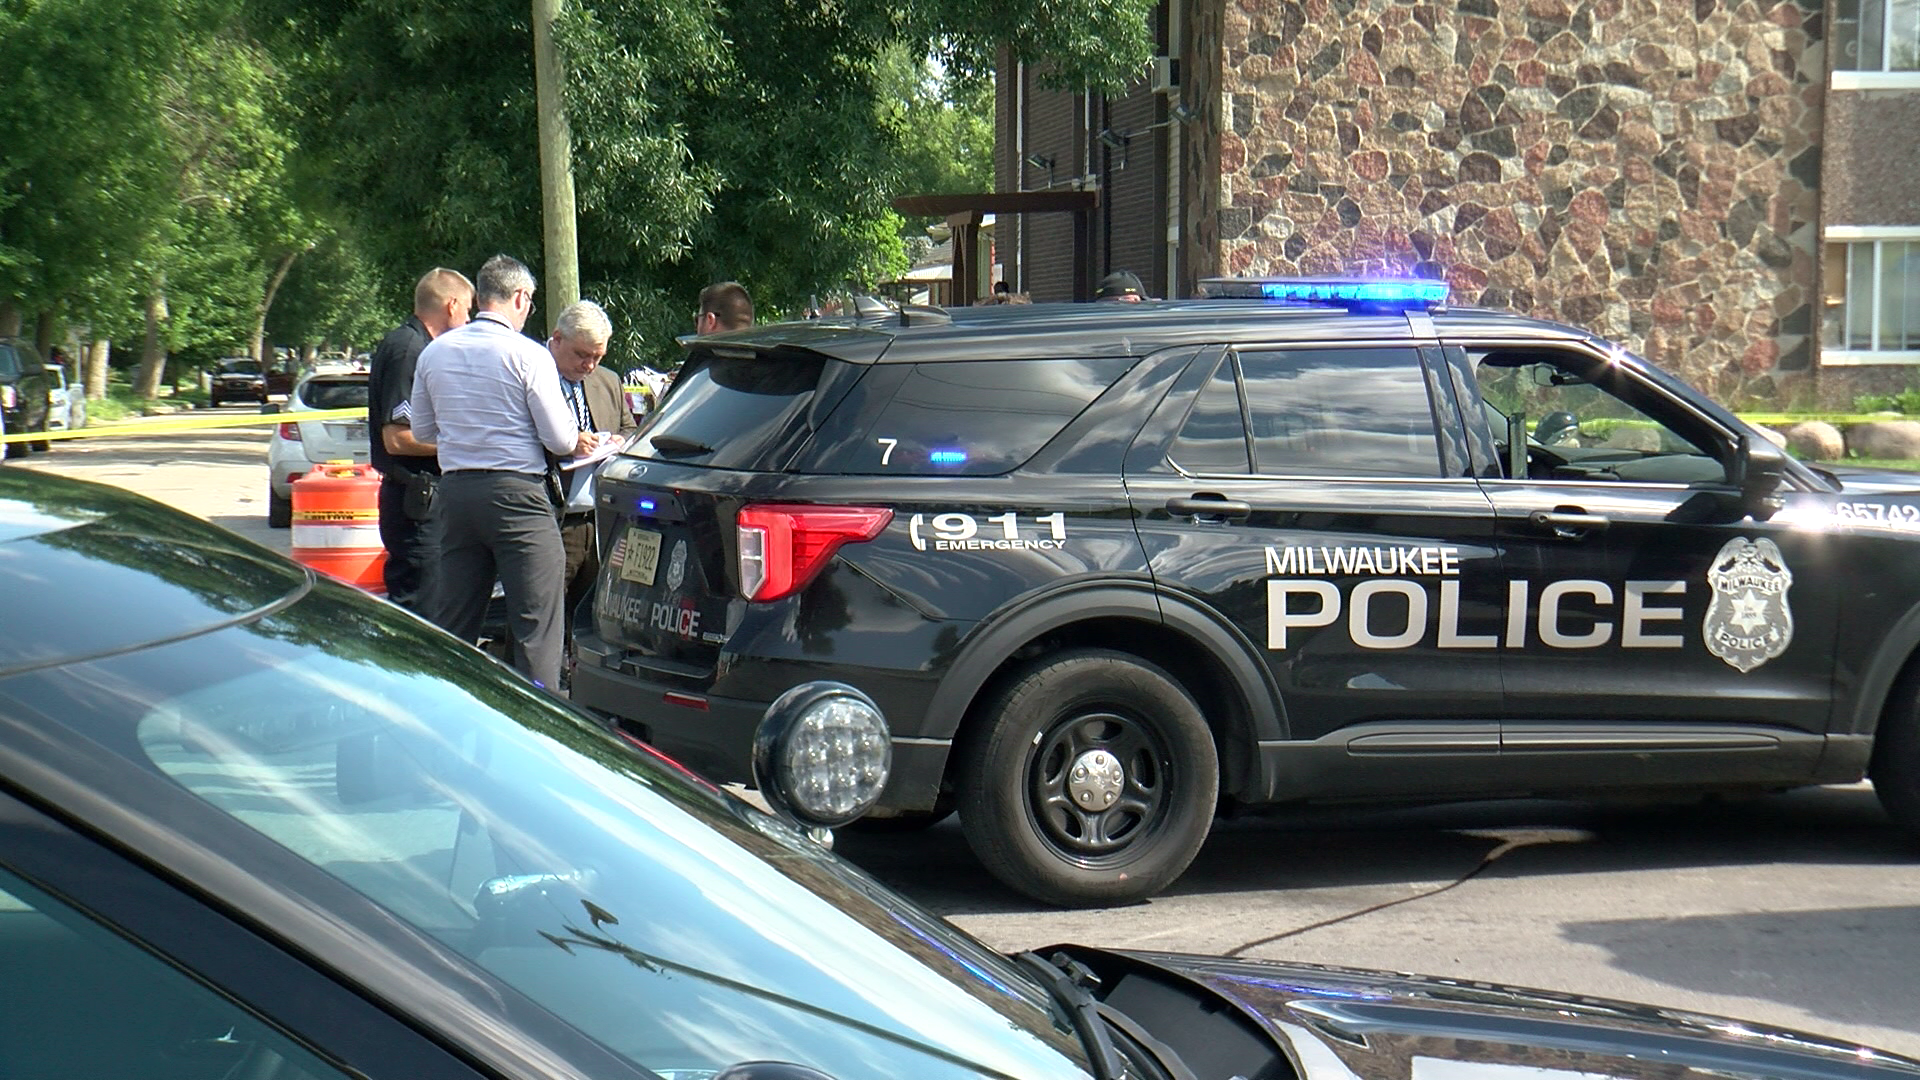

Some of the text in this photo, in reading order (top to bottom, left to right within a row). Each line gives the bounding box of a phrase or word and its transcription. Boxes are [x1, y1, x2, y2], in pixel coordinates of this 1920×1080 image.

[878, 438, 898, 465] 7
[932, 512, 1067, 540] 911
[935, 540, 1066, 551] EMERGENCY
[1264, 546, 1460, 575] MILWAUKEE
[1721, 577, 1780, 592] MILWAUKEE
[650, 602, 701, 638] POLICE
[1267, 579, 1687, 650] POLICE
